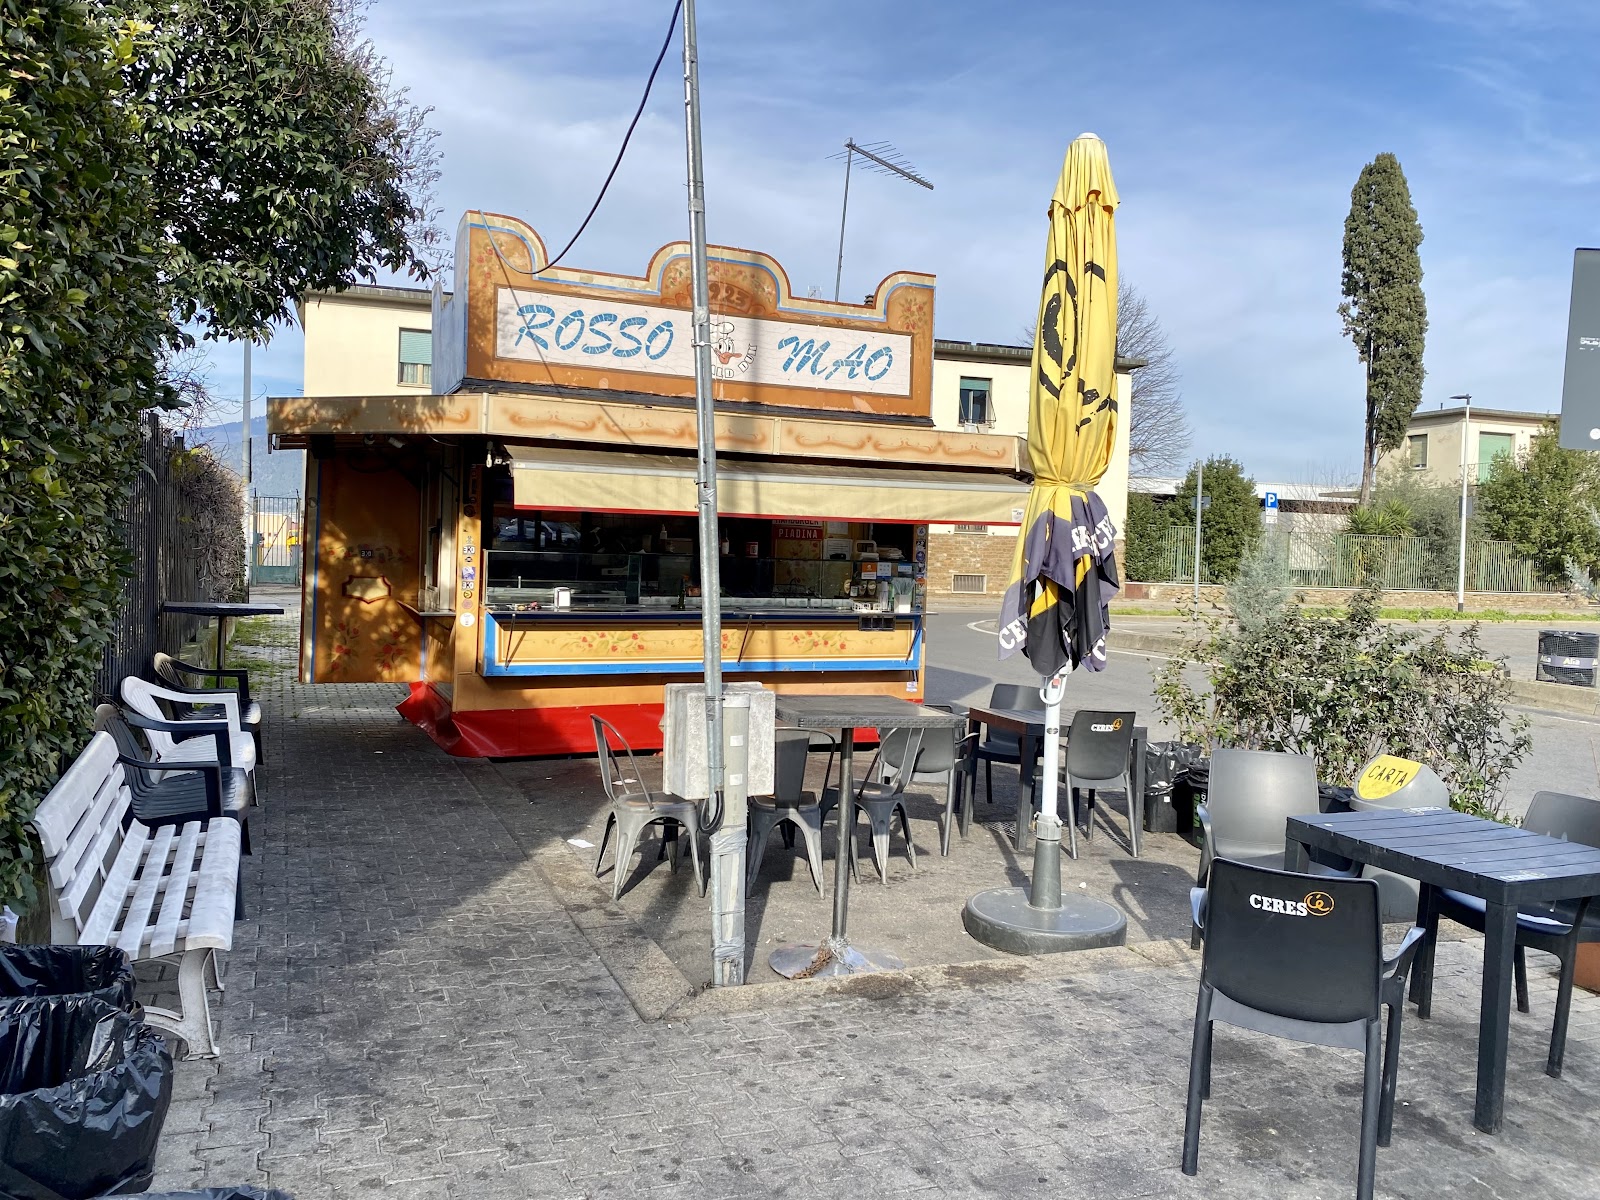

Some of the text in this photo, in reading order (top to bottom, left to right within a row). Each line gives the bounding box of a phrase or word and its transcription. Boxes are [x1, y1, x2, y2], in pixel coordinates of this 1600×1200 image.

[514, 304, 893, 381] ROSSO MAO
[1267, 493, 1276, 507] P
[778, 528, 818, 539] PIADINA
[1090, 723, 1114, 732] CERES
[1368, 765, 1408, 787] CARTA
[1249, 893, 1308, 917] CERES
